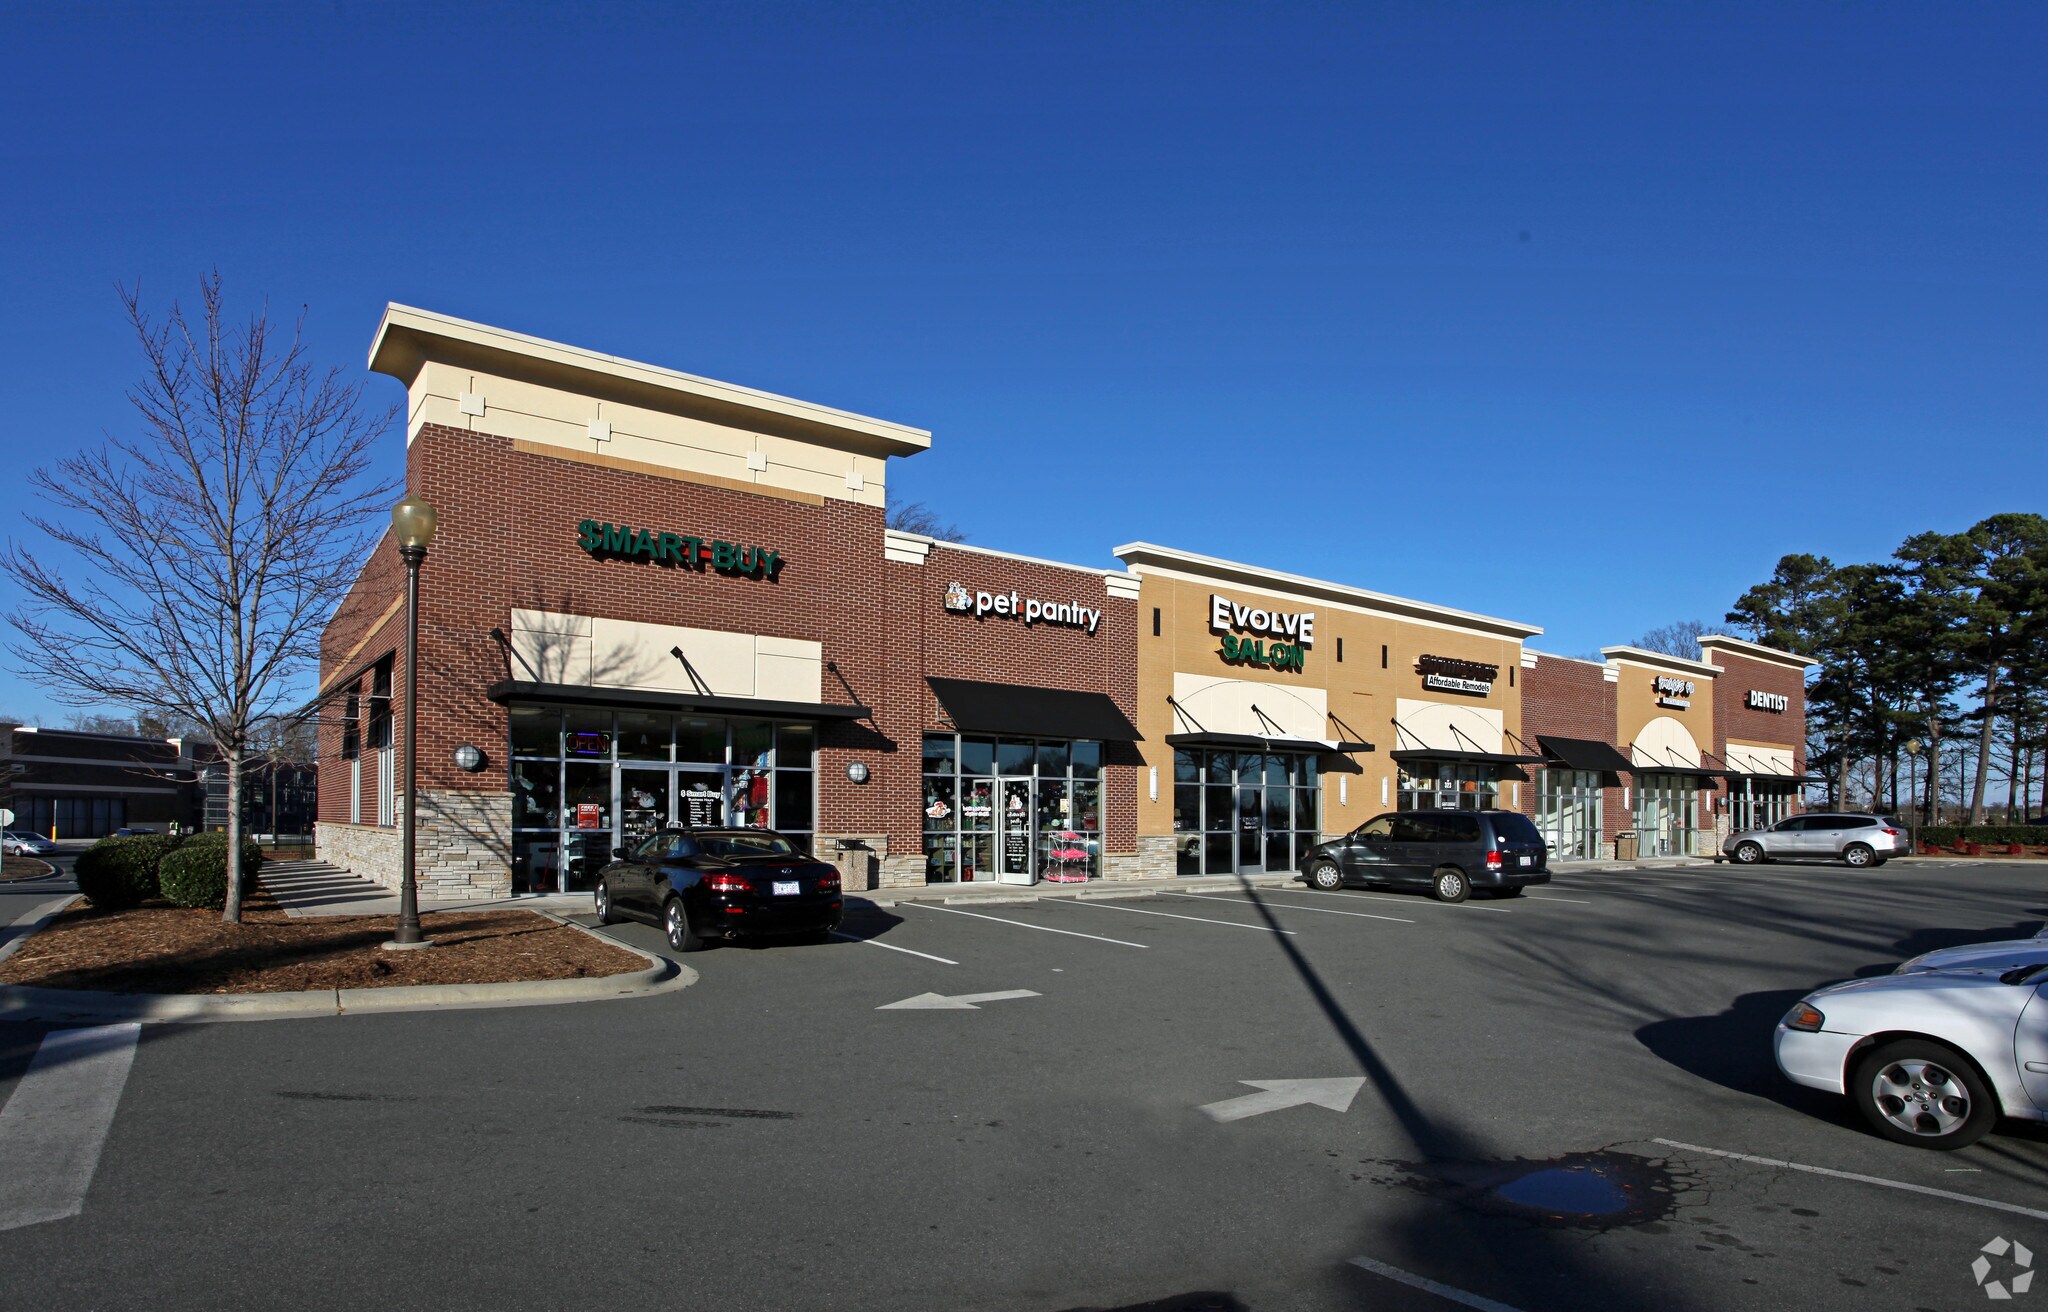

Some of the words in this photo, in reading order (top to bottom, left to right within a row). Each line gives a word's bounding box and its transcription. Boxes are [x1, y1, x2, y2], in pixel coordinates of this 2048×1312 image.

[711, 541, 780, 575] BUY
[976, 590, 1019, 616] pet
[1026, 599, 1101, 632] pantry
[1212, 594, 1315, 643] EVOLVE
[1222, 635, 1305, 668] SALON
[1428, 675, 1461, 689] Affordable
[1462, 680, 1490, 693] Remodels
[1750, 689, 1789, 712] DENTIST
[568, 735, 607, 751] OPEN
